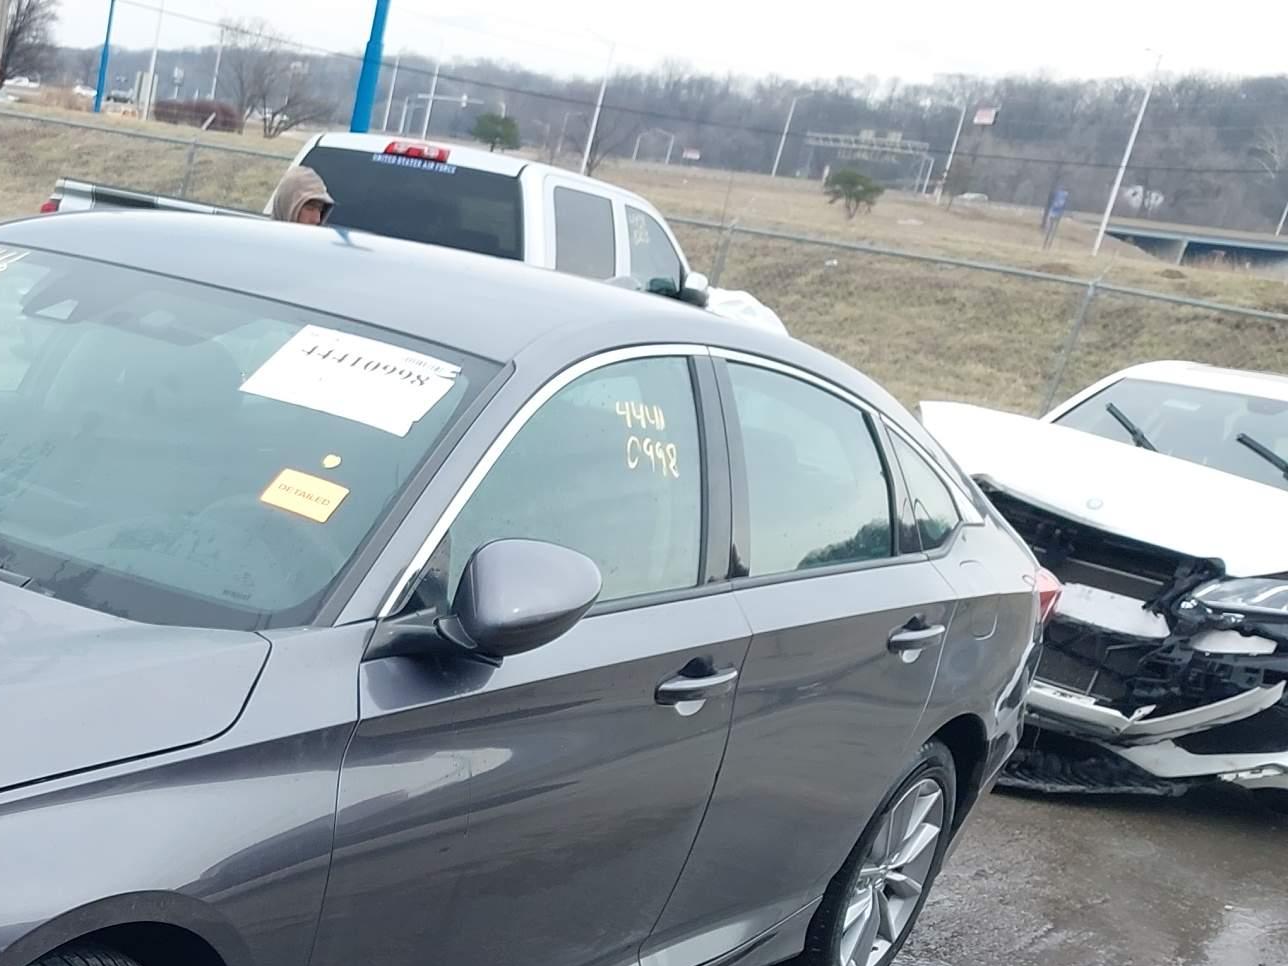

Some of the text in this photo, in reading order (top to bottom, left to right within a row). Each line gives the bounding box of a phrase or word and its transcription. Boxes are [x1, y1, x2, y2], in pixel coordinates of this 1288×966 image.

[373, 153, 457, 174] UNITED STATES AIR FORCE
[301, 344, 431, 387] 44410998
[615, 400, 665, 431] 4441
[278, 483, 331, 507] DETAILED
